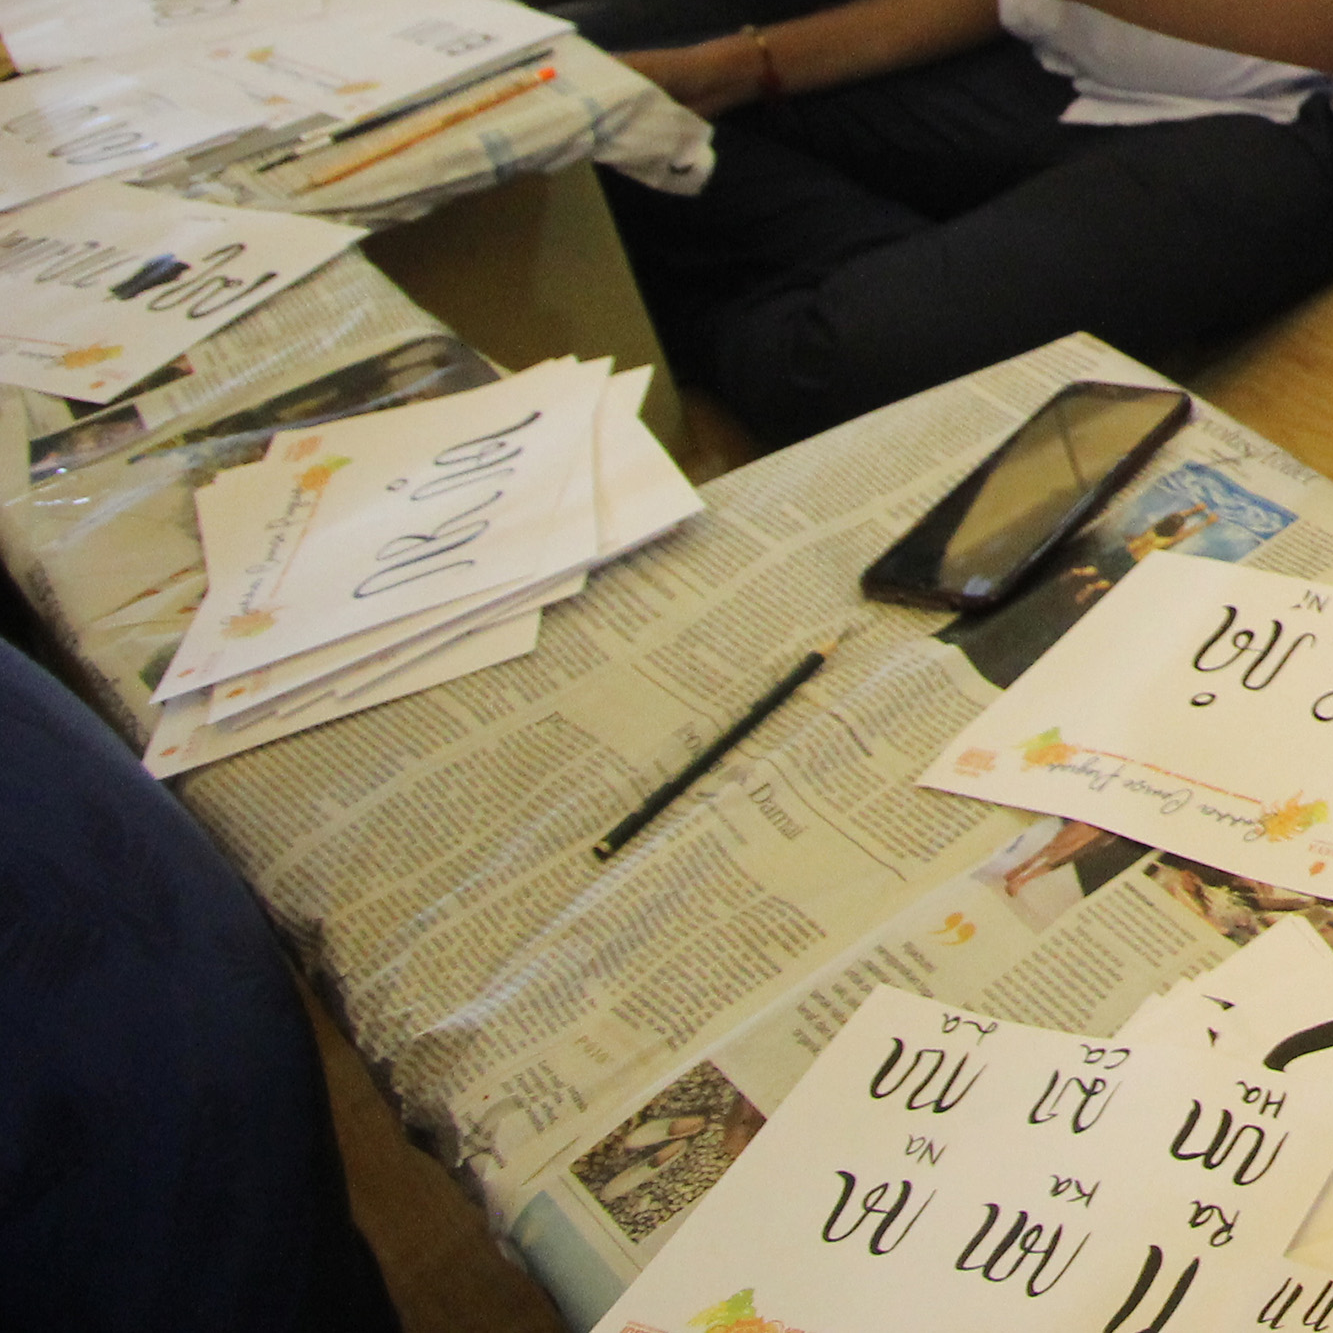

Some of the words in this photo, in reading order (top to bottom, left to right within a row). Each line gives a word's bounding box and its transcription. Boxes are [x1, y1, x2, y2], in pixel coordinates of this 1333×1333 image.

[746, 781, 811, 842] Damai
[1079, 1042, 1131, 1071] Ca
[1235, 1080, 1288, 1119] Ha
[904, 1134, 948, 1168] Na
[1050, 1173, 1101, 1208] Ka
[1187, 1198, 1240, 1247] Ra
